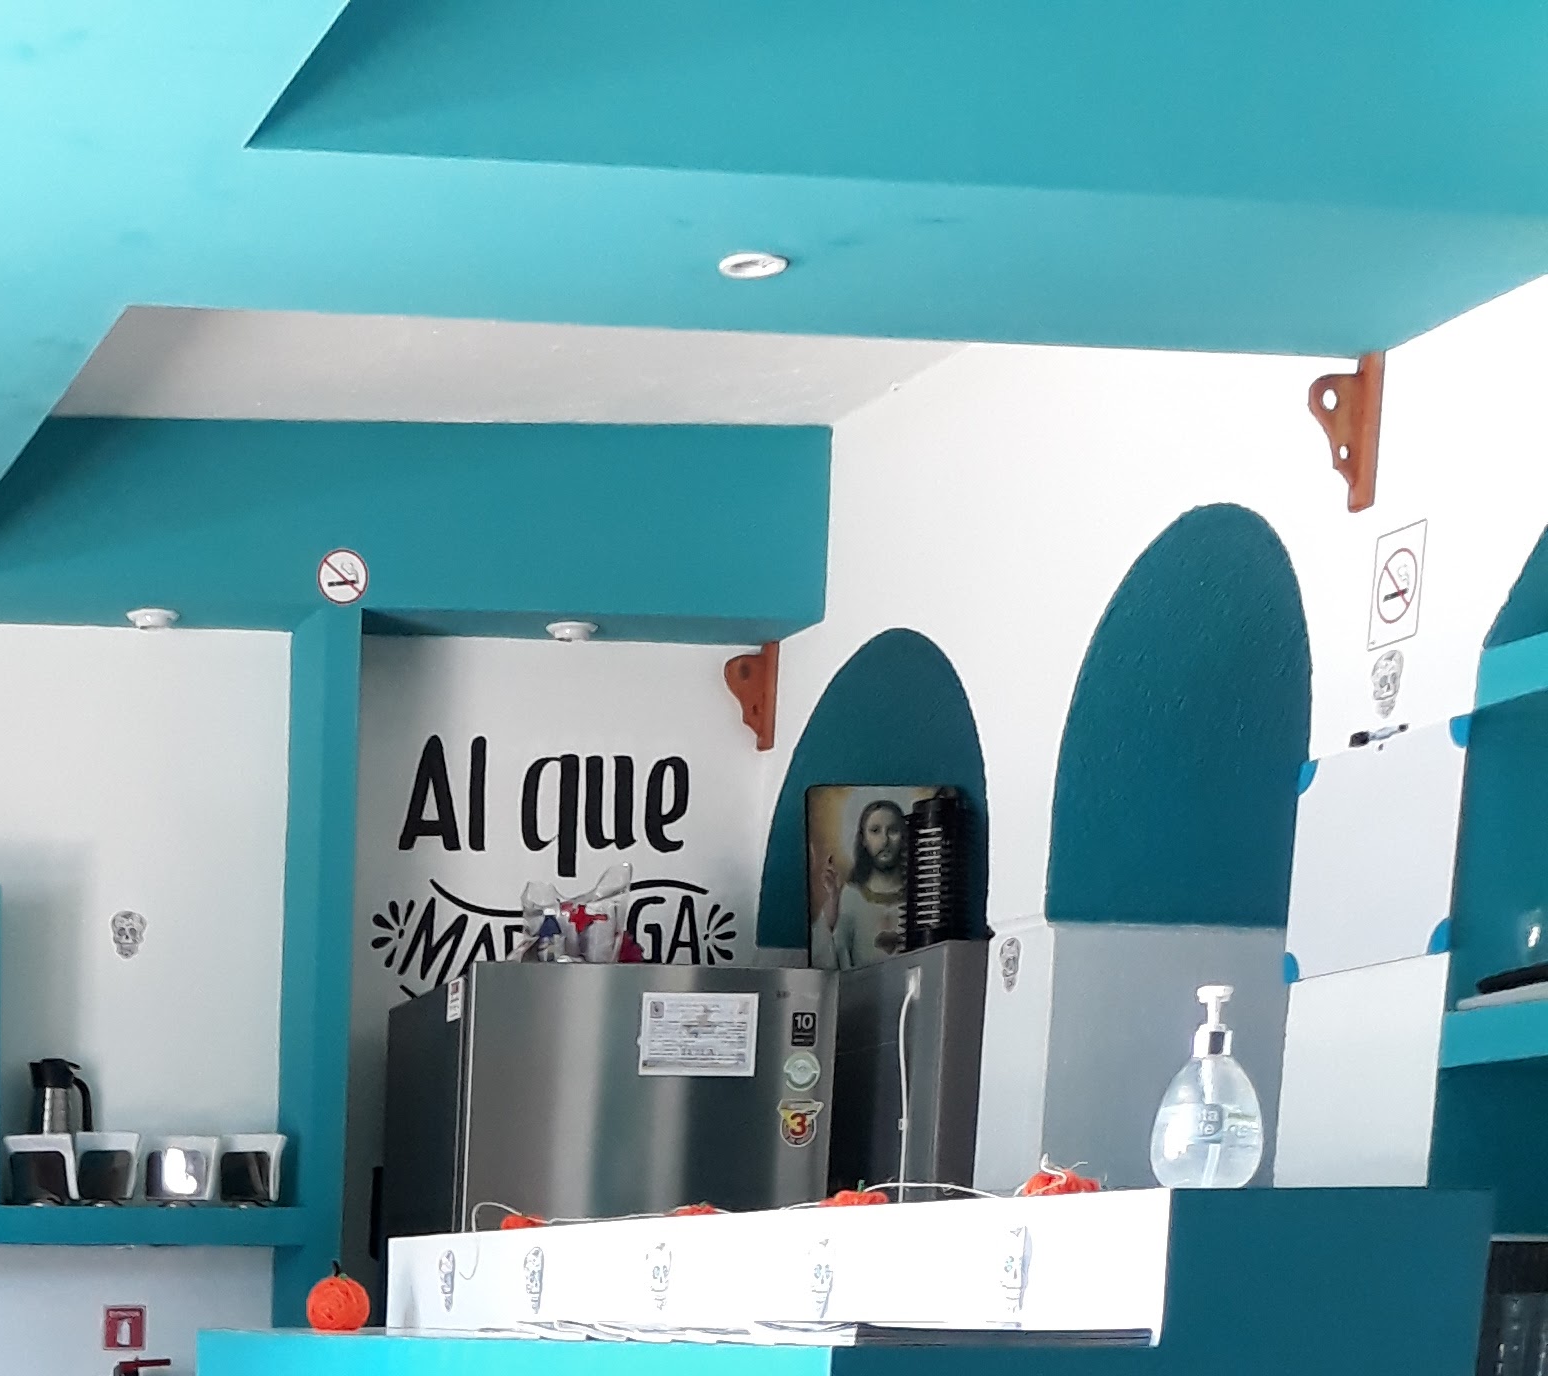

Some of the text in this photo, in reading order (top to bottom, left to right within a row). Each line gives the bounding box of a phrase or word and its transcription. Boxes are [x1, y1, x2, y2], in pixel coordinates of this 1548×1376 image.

[398, 734, 690, 878] Al que
[794, 1014, 814, 1030] 10
